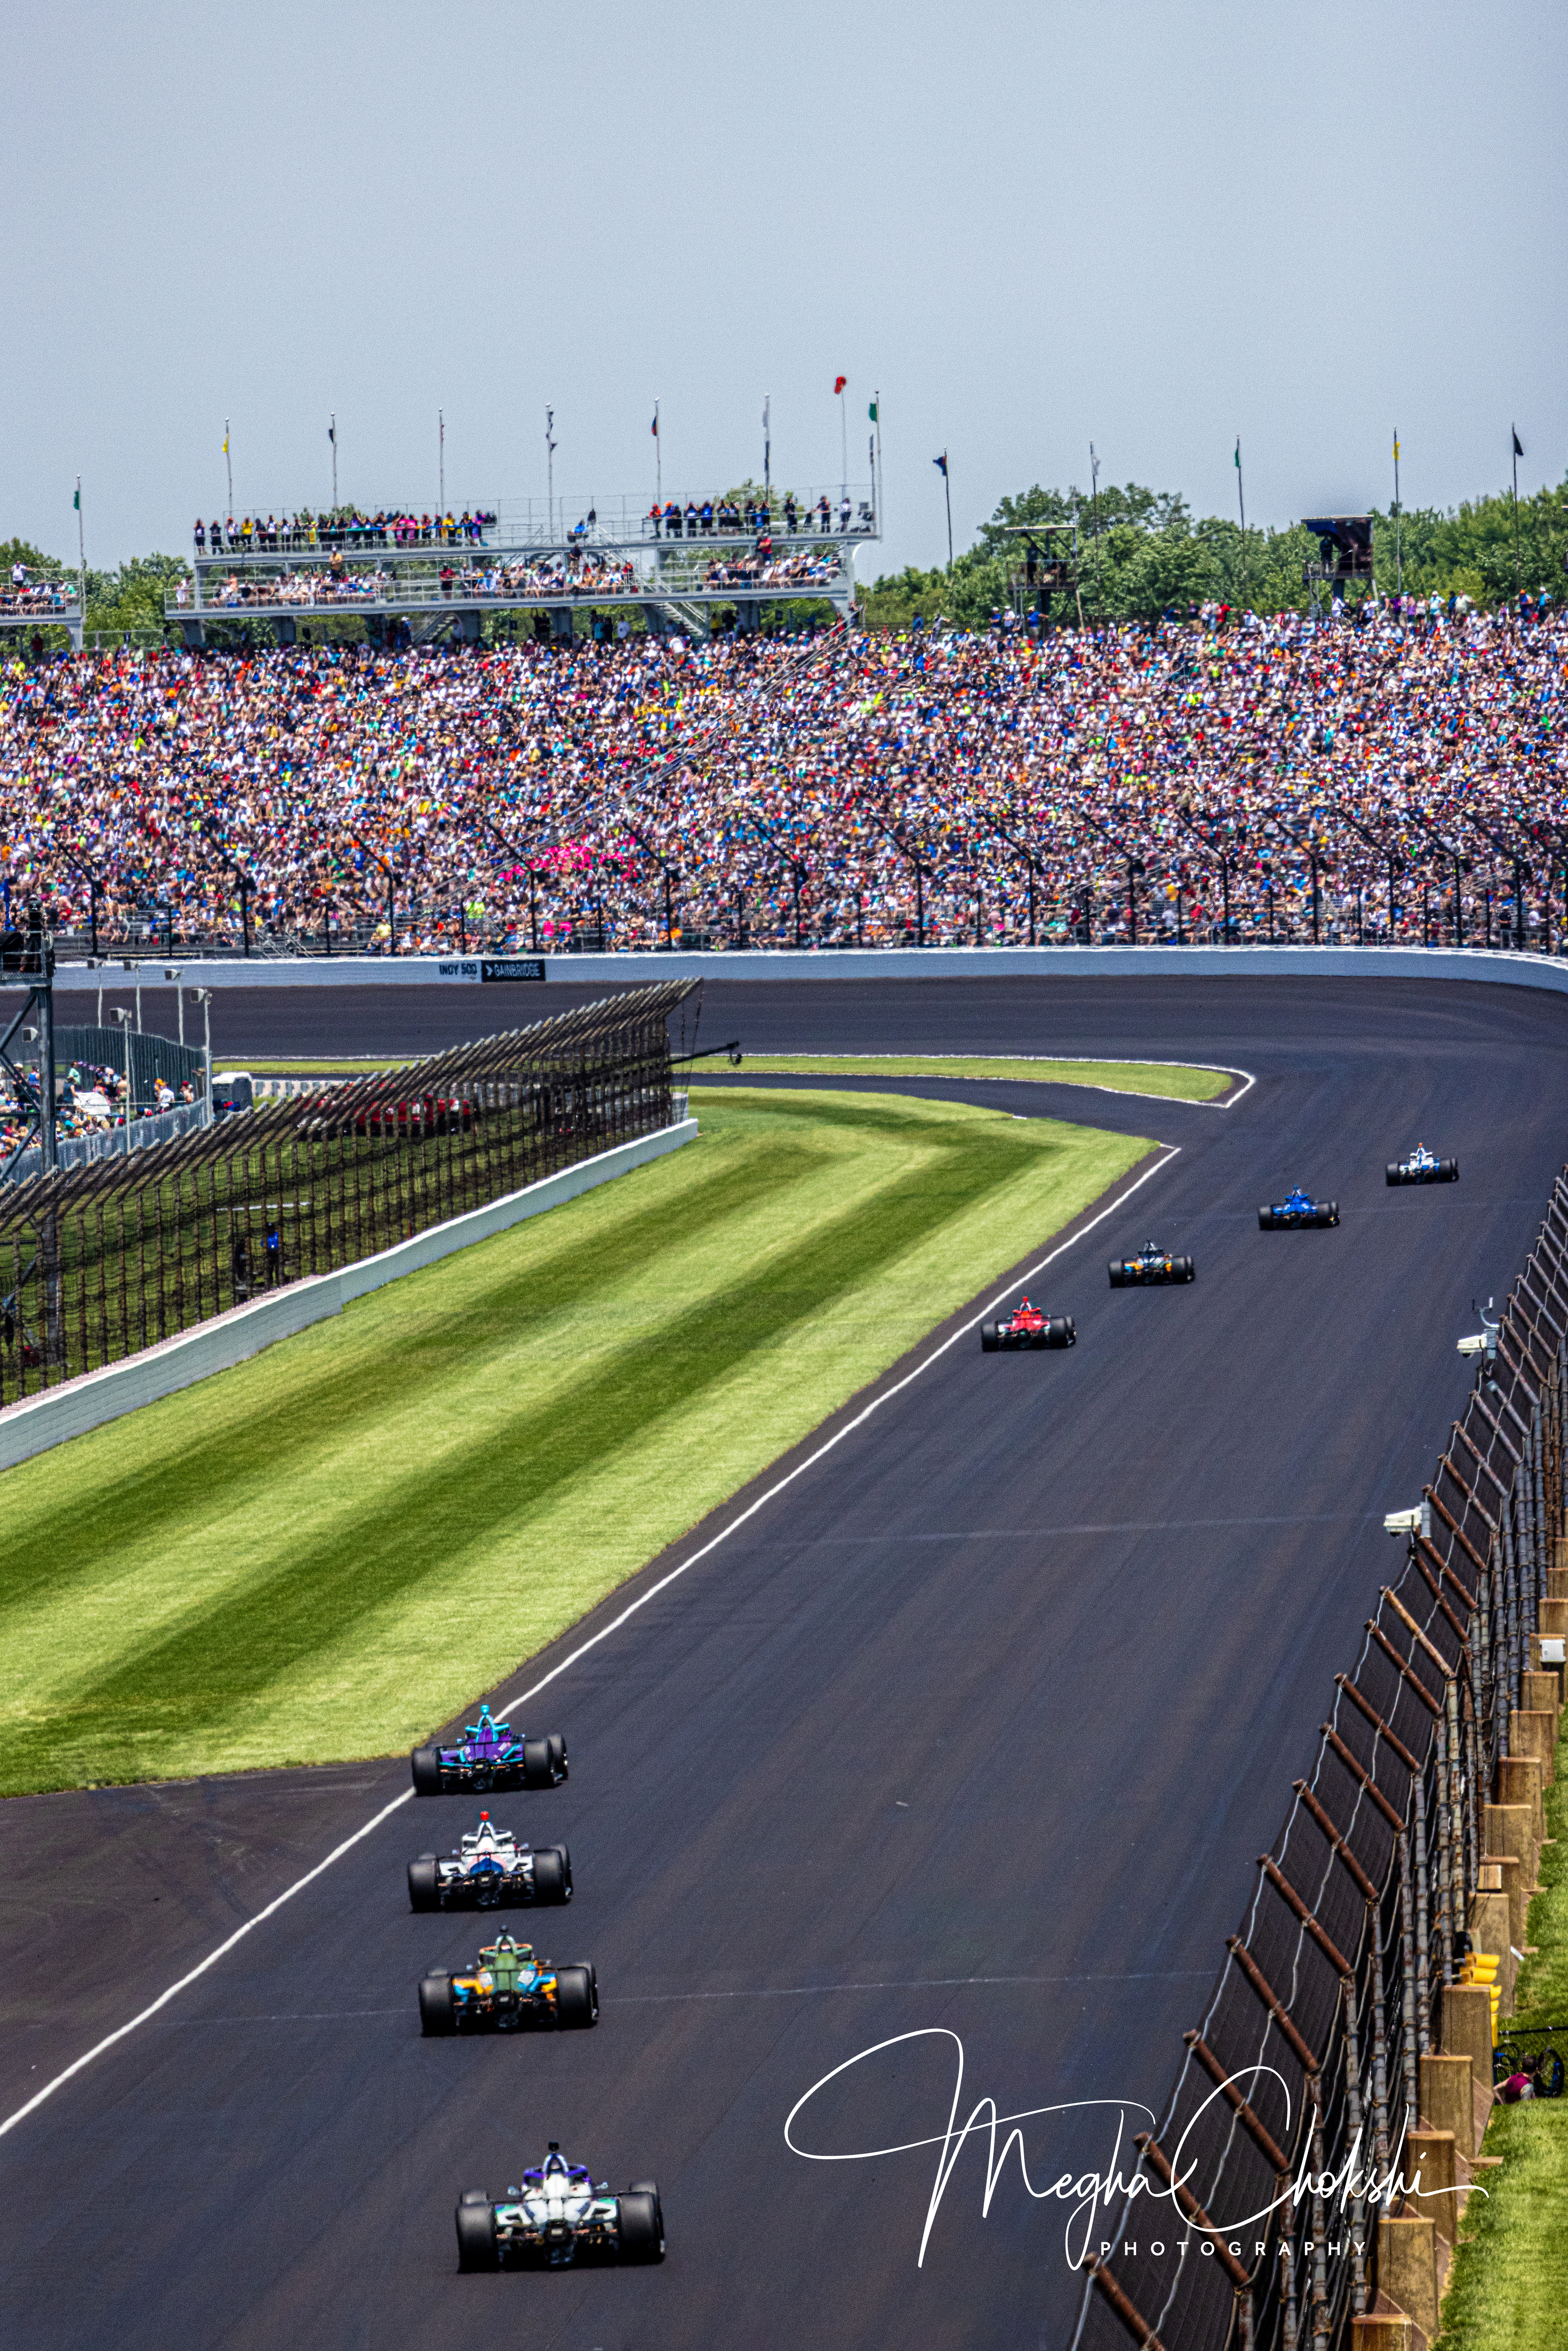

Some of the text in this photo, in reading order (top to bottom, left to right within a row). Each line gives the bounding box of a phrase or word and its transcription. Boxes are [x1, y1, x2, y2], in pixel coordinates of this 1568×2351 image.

[439, 963, 477, 975] INDY 500
[494, 963, 540, 977] GAINBRIDGE
